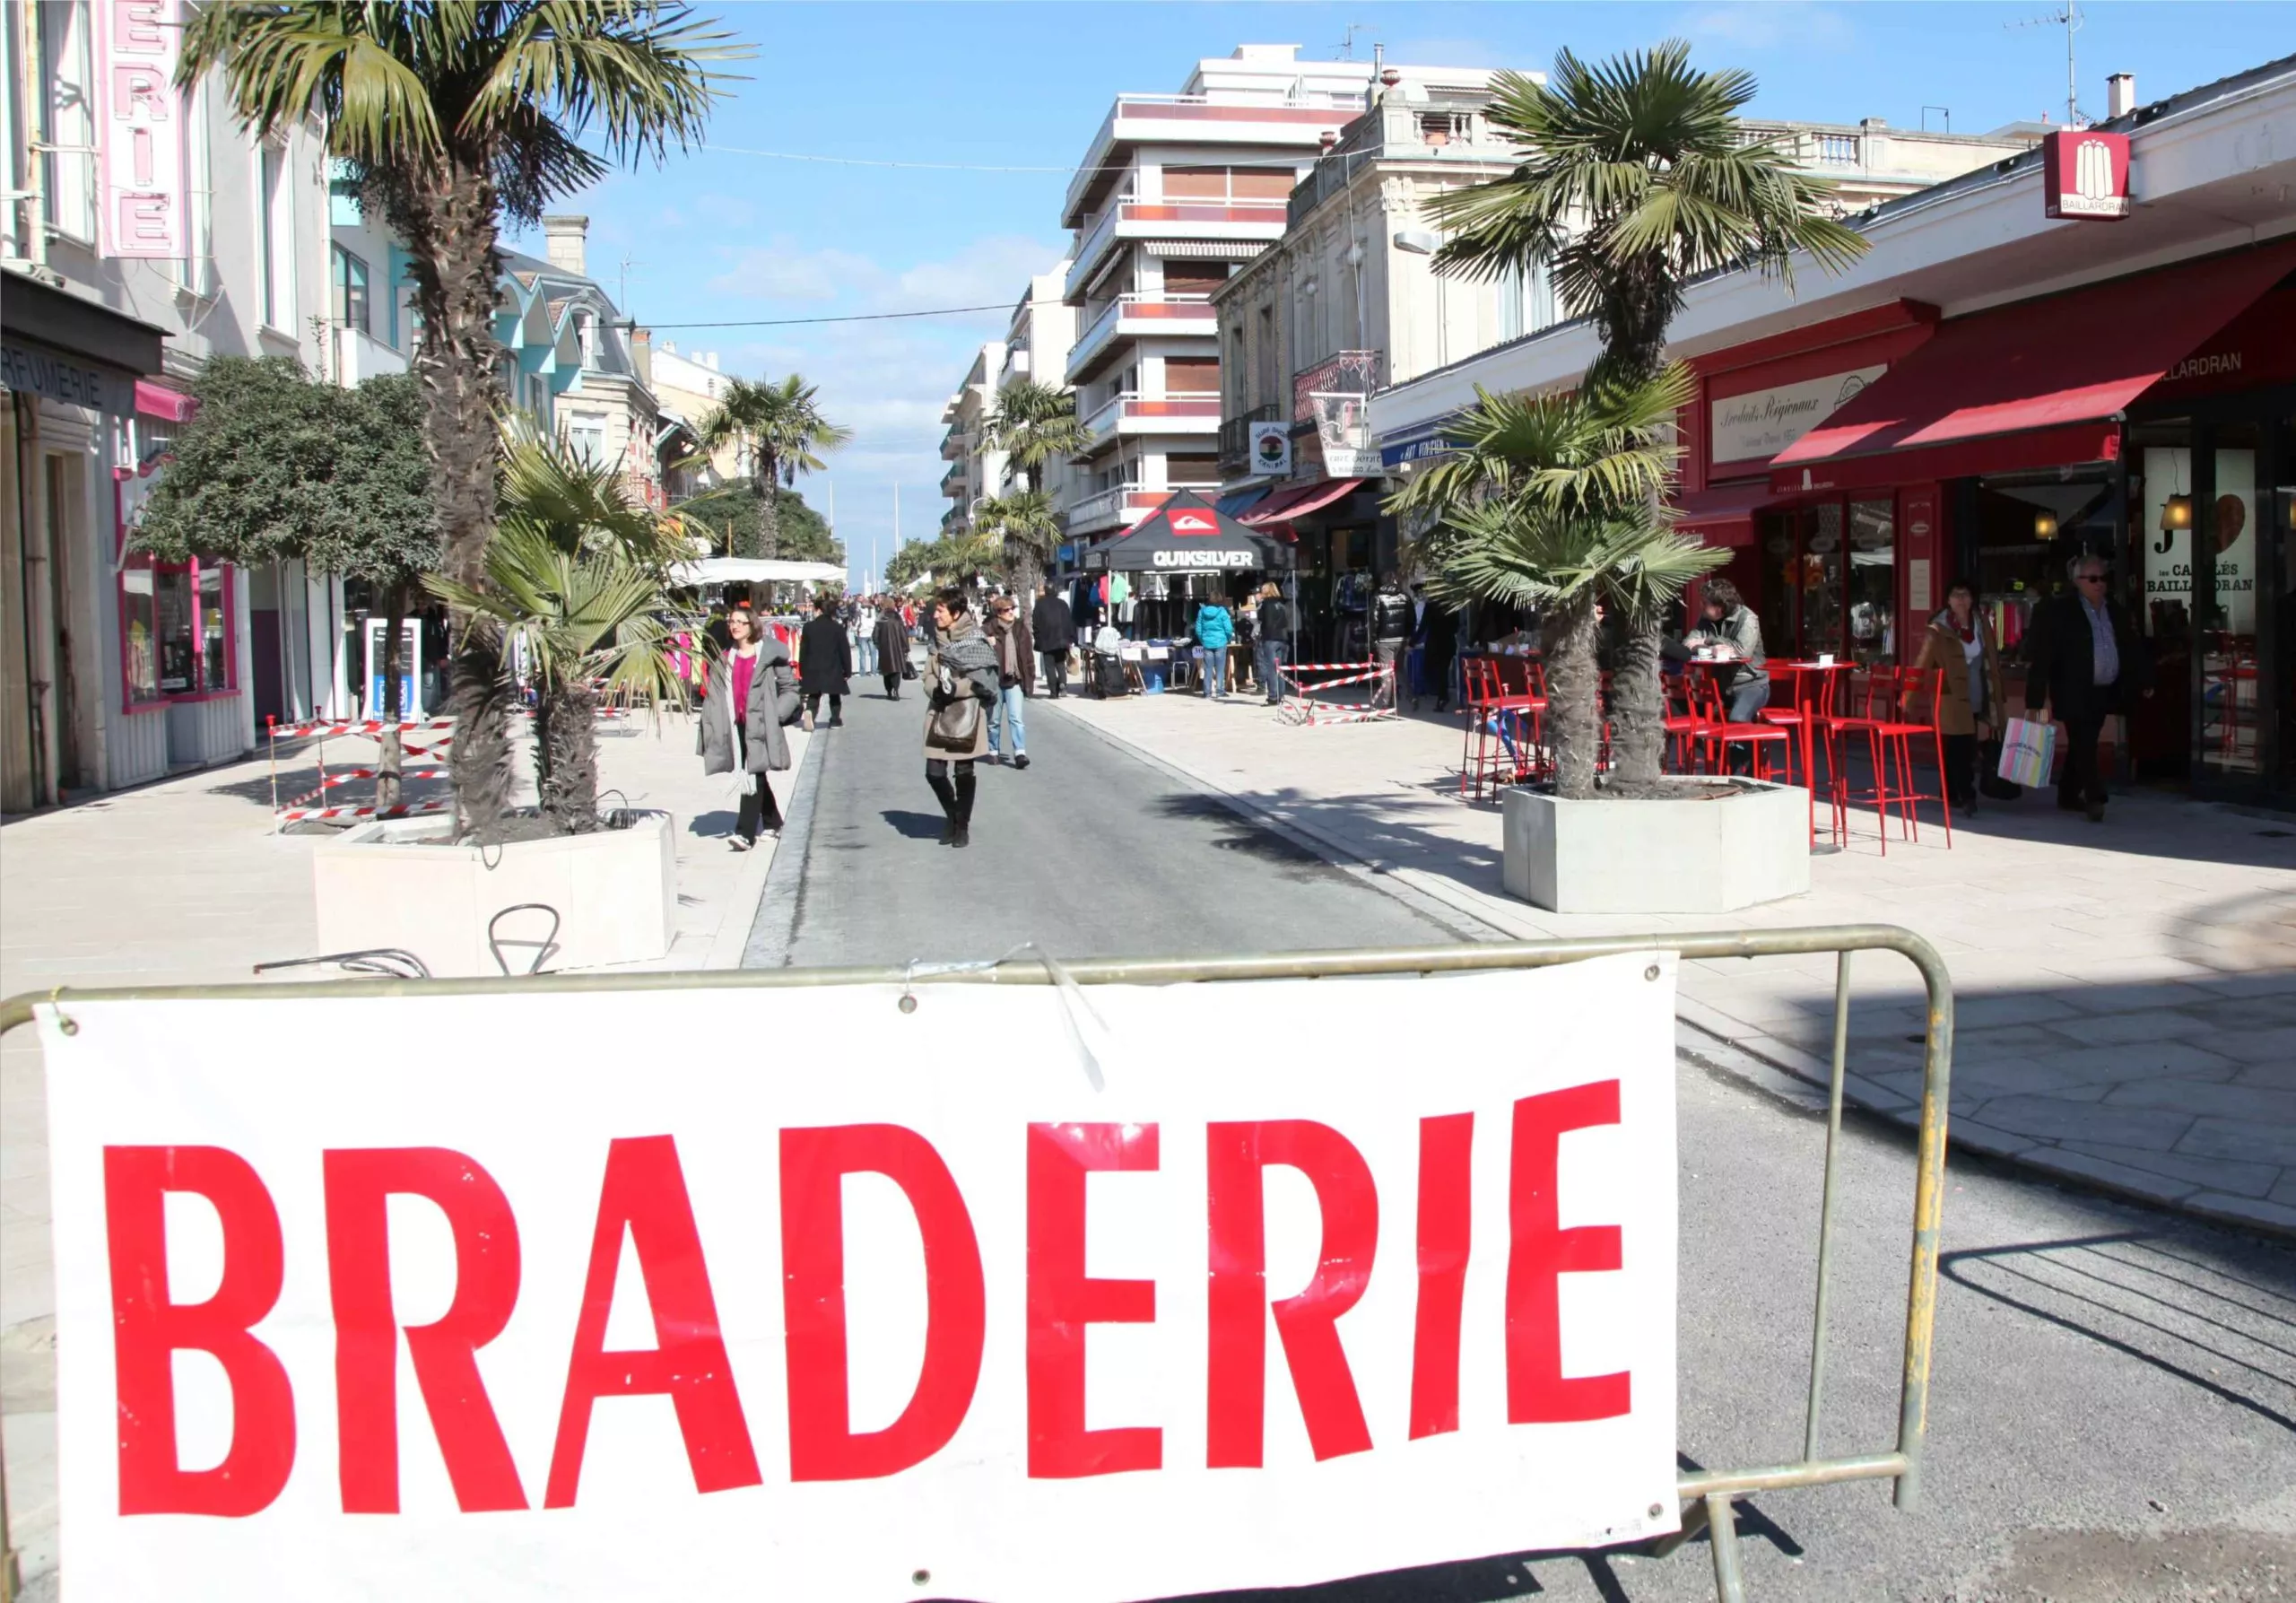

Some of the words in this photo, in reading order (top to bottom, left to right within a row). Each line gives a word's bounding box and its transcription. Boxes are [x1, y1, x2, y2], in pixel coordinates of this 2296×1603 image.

[2062, 199, 2128, 213] BAILLARDRAN
[1153, 551, 1253, 567] QUIKSILVER
[104, 1079, 1631, 1518] BRADERIE
